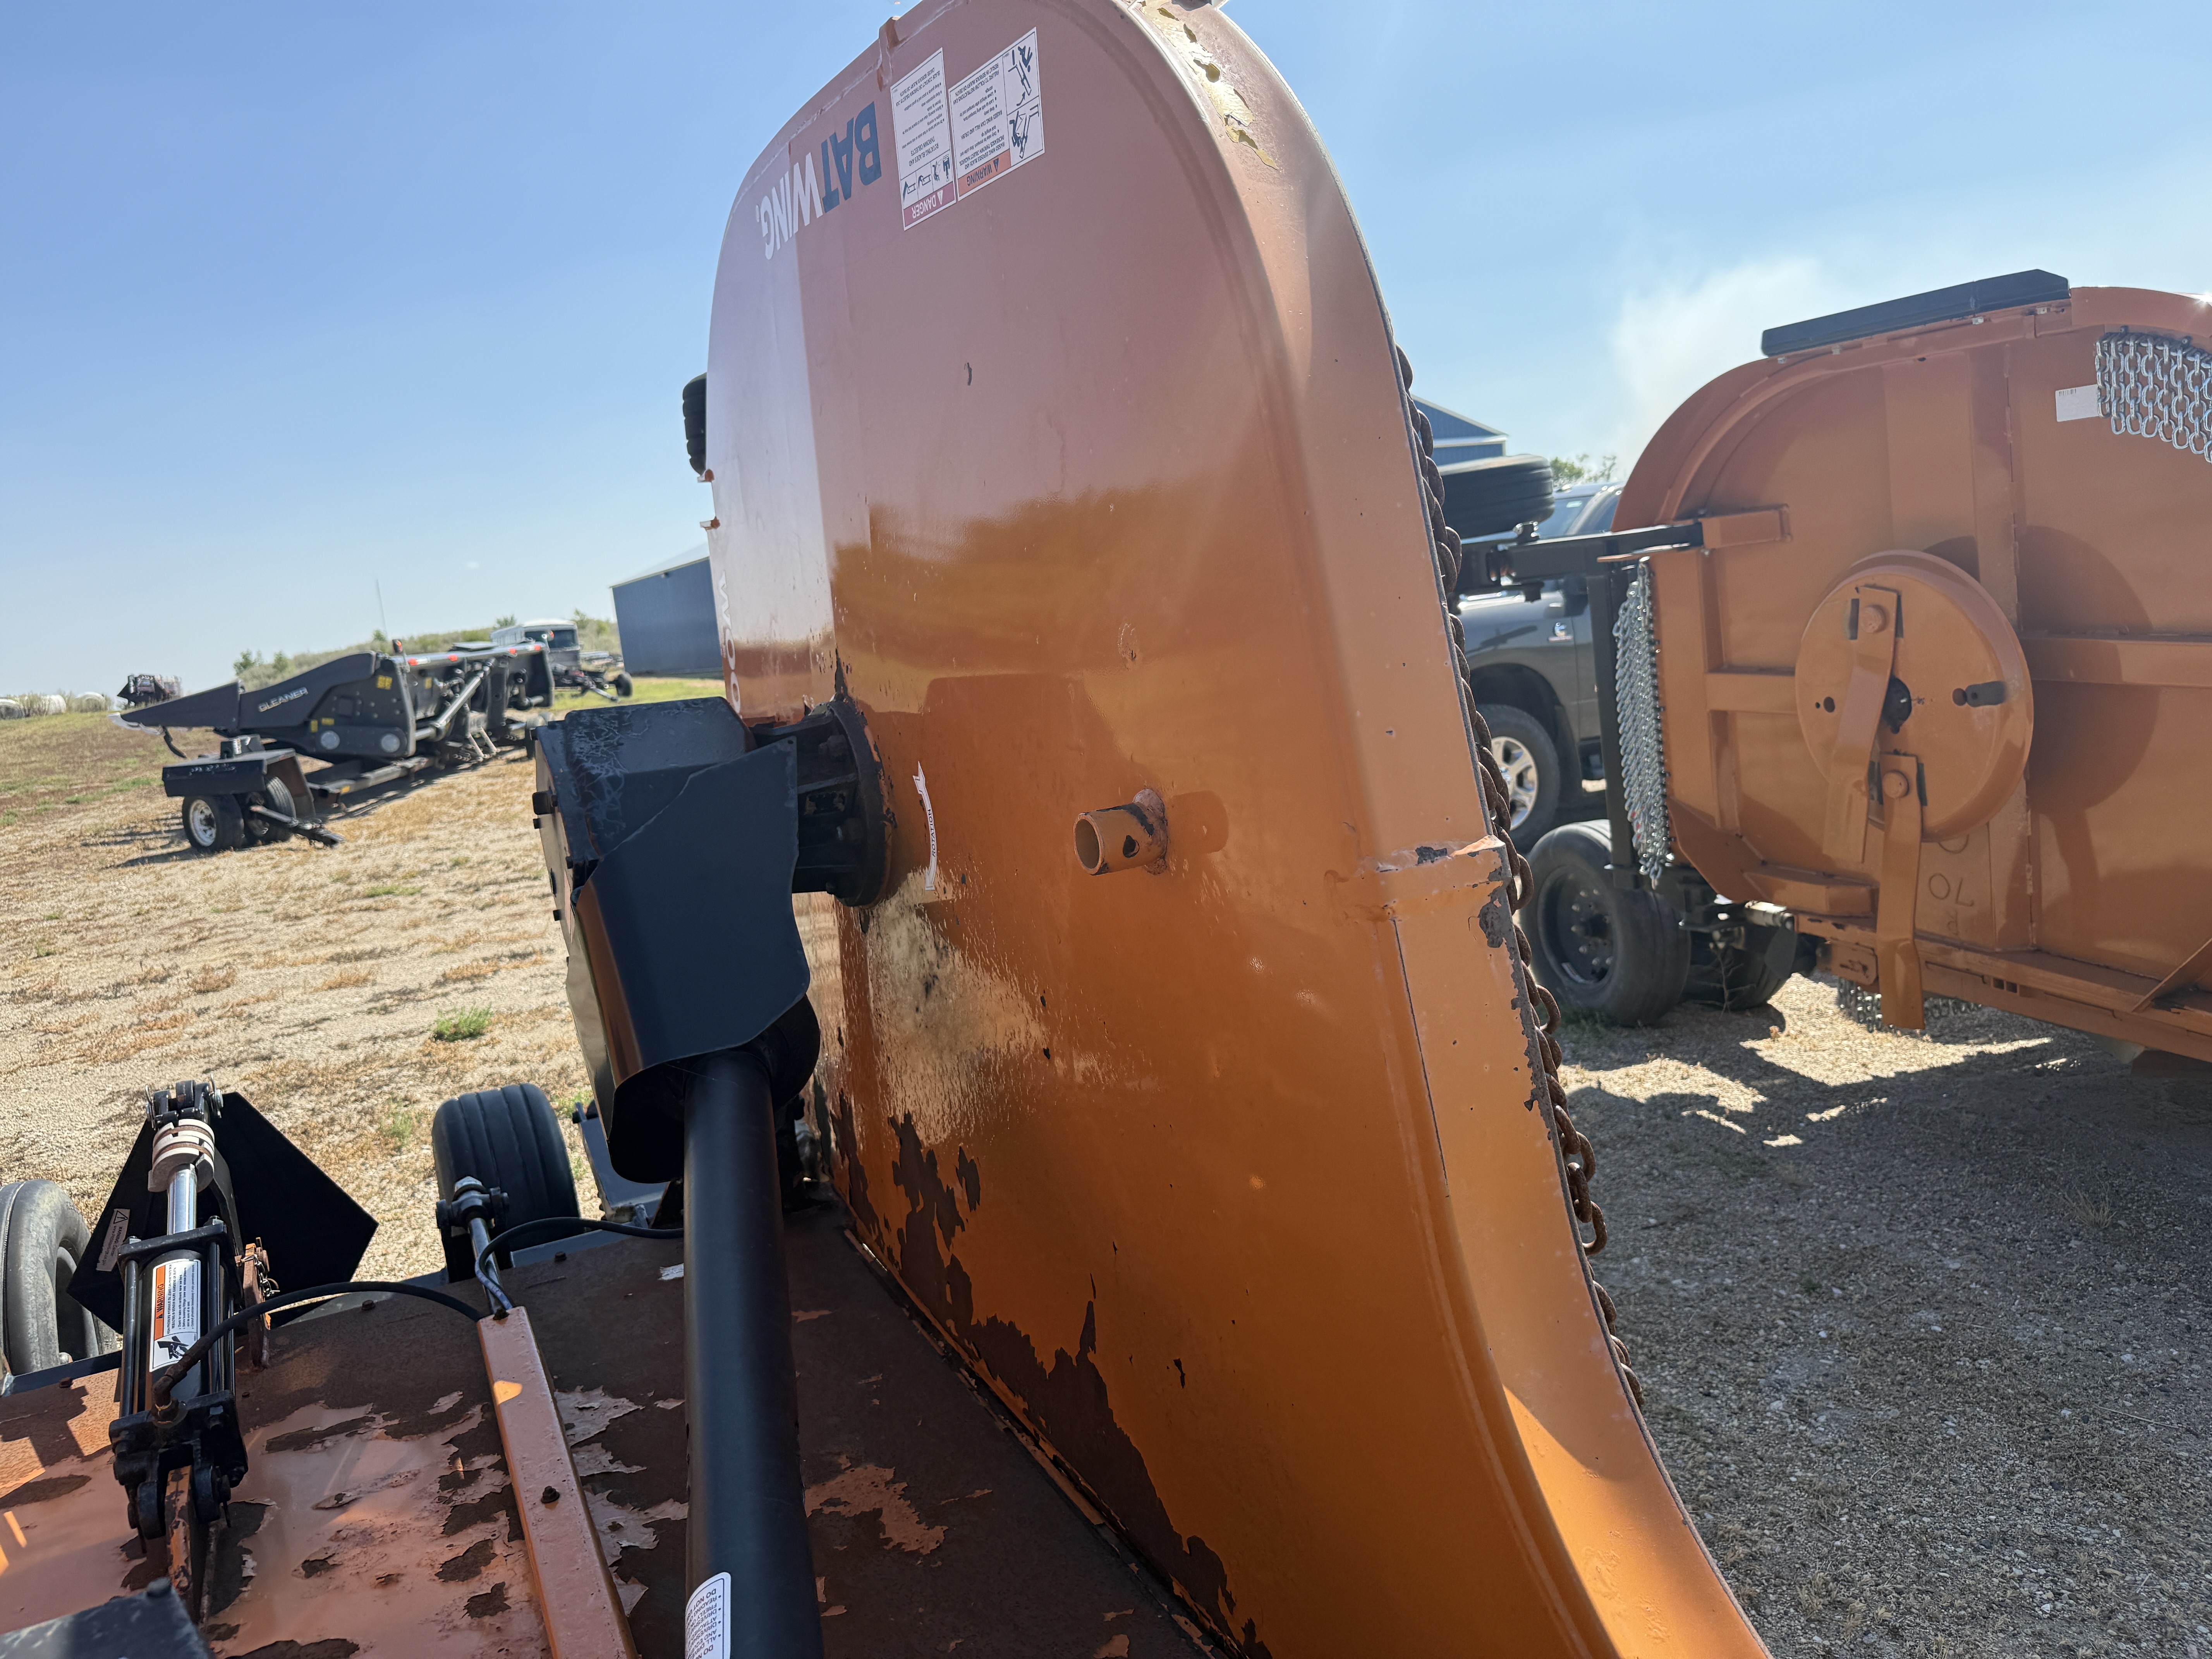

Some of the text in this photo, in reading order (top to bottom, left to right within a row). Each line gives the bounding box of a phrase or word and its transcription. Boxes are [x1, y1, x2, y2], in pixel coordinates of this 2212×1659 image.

[760, 101, 882, 260] BATWING
[967, 163, 992, 186] WARNING
[911, 194, 936, 218] DANGER
[719, 570, 741, 715] WOO
[706, 1589, 716, 1598] DO
[693, 1596, 704, 1611] NOT
[694, 1595, 716, 1616] READING
[697, 1603, 716, 1621] FREELY
[704, 1629, 716, 1640] AND
[706, 1635, 716, 1644] ALL
[704, 1644, 713, 1655] DO
